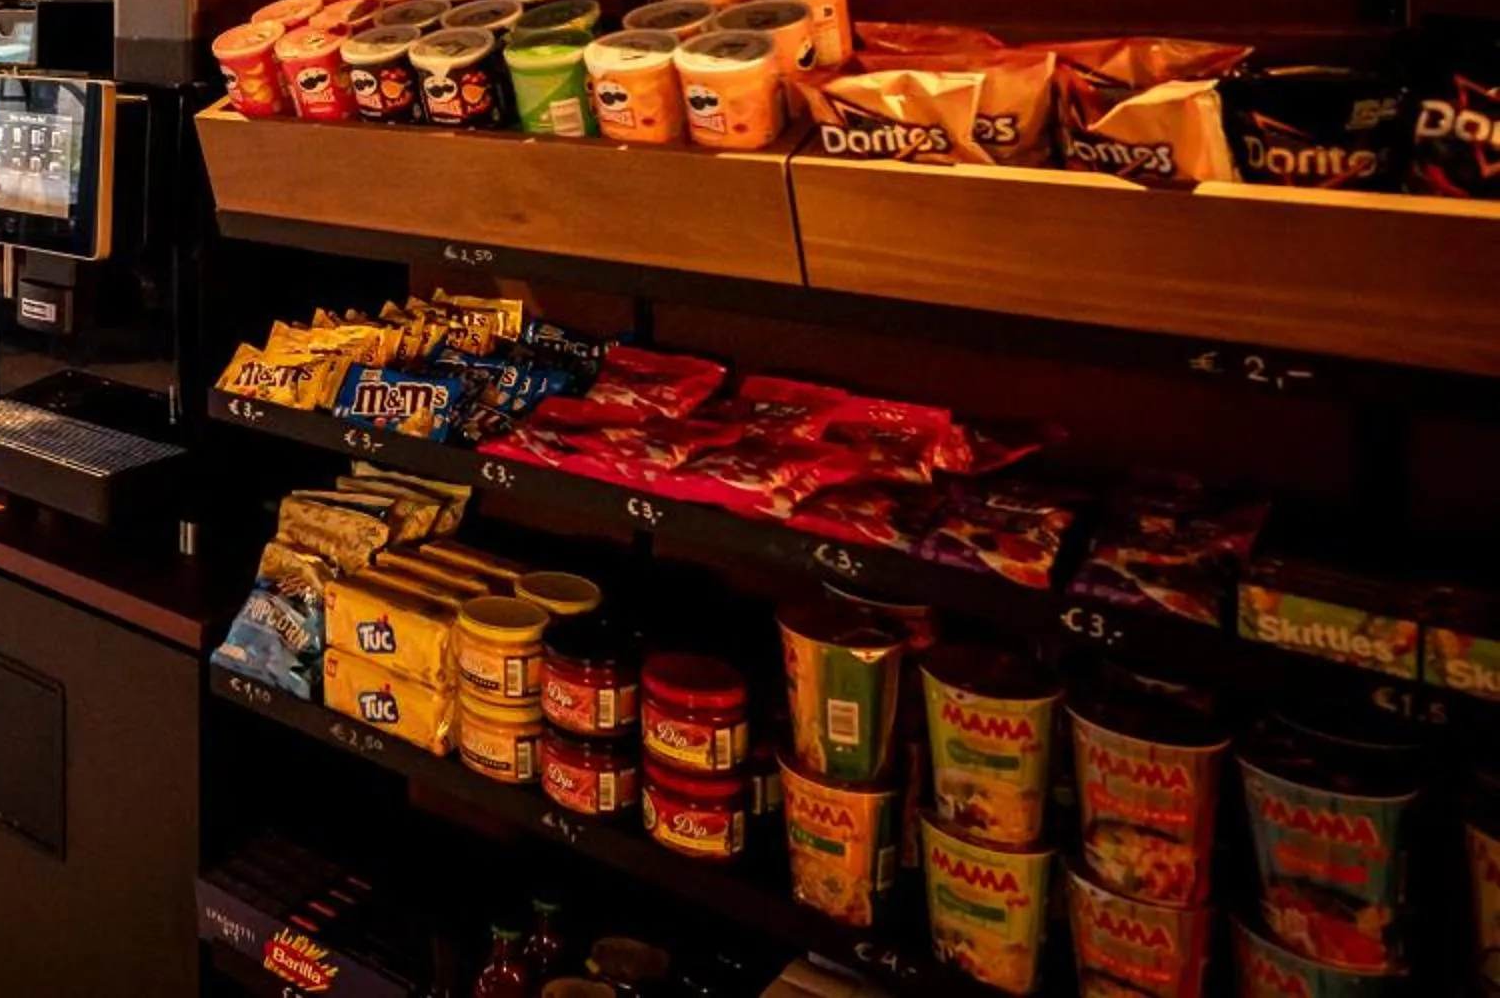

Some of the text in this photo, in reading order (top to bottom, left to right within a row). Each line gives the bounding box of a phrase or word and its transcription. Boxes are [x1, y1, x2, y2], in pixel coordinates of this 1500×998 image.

[820, 123, 948, 154] Doritos
[1256, 613, 1395, 663] Skittles
[941, 702, 1032, 740] MAMA
[1089, 746, 1188, 788] MAMA
[1262, 793, 1377, 845] MAMA
[932, 847, 1020, 893] MAMA
[271, 945, 322, 984] Barilla
